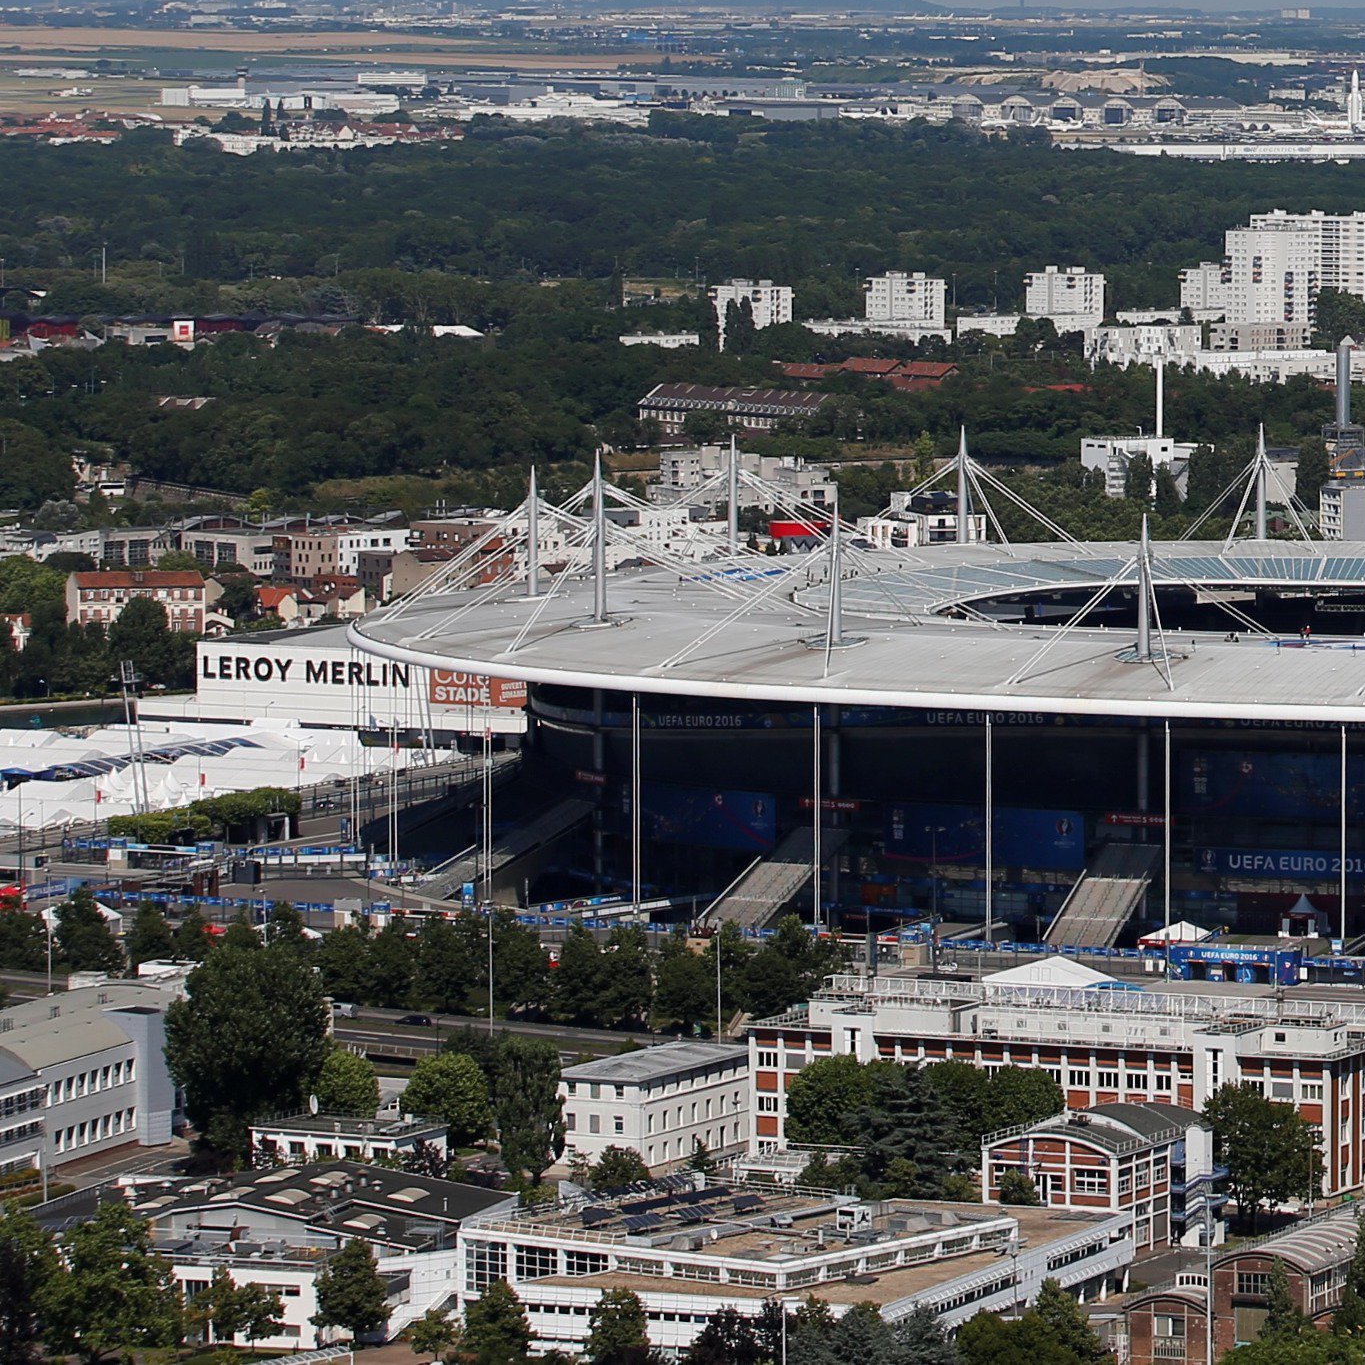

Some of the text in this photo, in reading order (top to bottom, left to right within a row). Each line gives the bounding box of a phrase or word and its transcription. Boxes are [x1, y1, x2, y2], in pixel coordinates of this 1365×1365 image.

[203, 655, 410, 688] LEROY MERLIN
[435, 686, 490, 703] STADE
[658, 715, 742, 727] UEFA EURO 2016
[926, 713, 963, 724] UEFA
[1008, 714, 1044, 724] 2016
[1228, 854, 1275, 870] UEFA
[1279, 856, 1327, 872] EURO
[1201, 951, 1258, 961] UEFA EURO 2016
